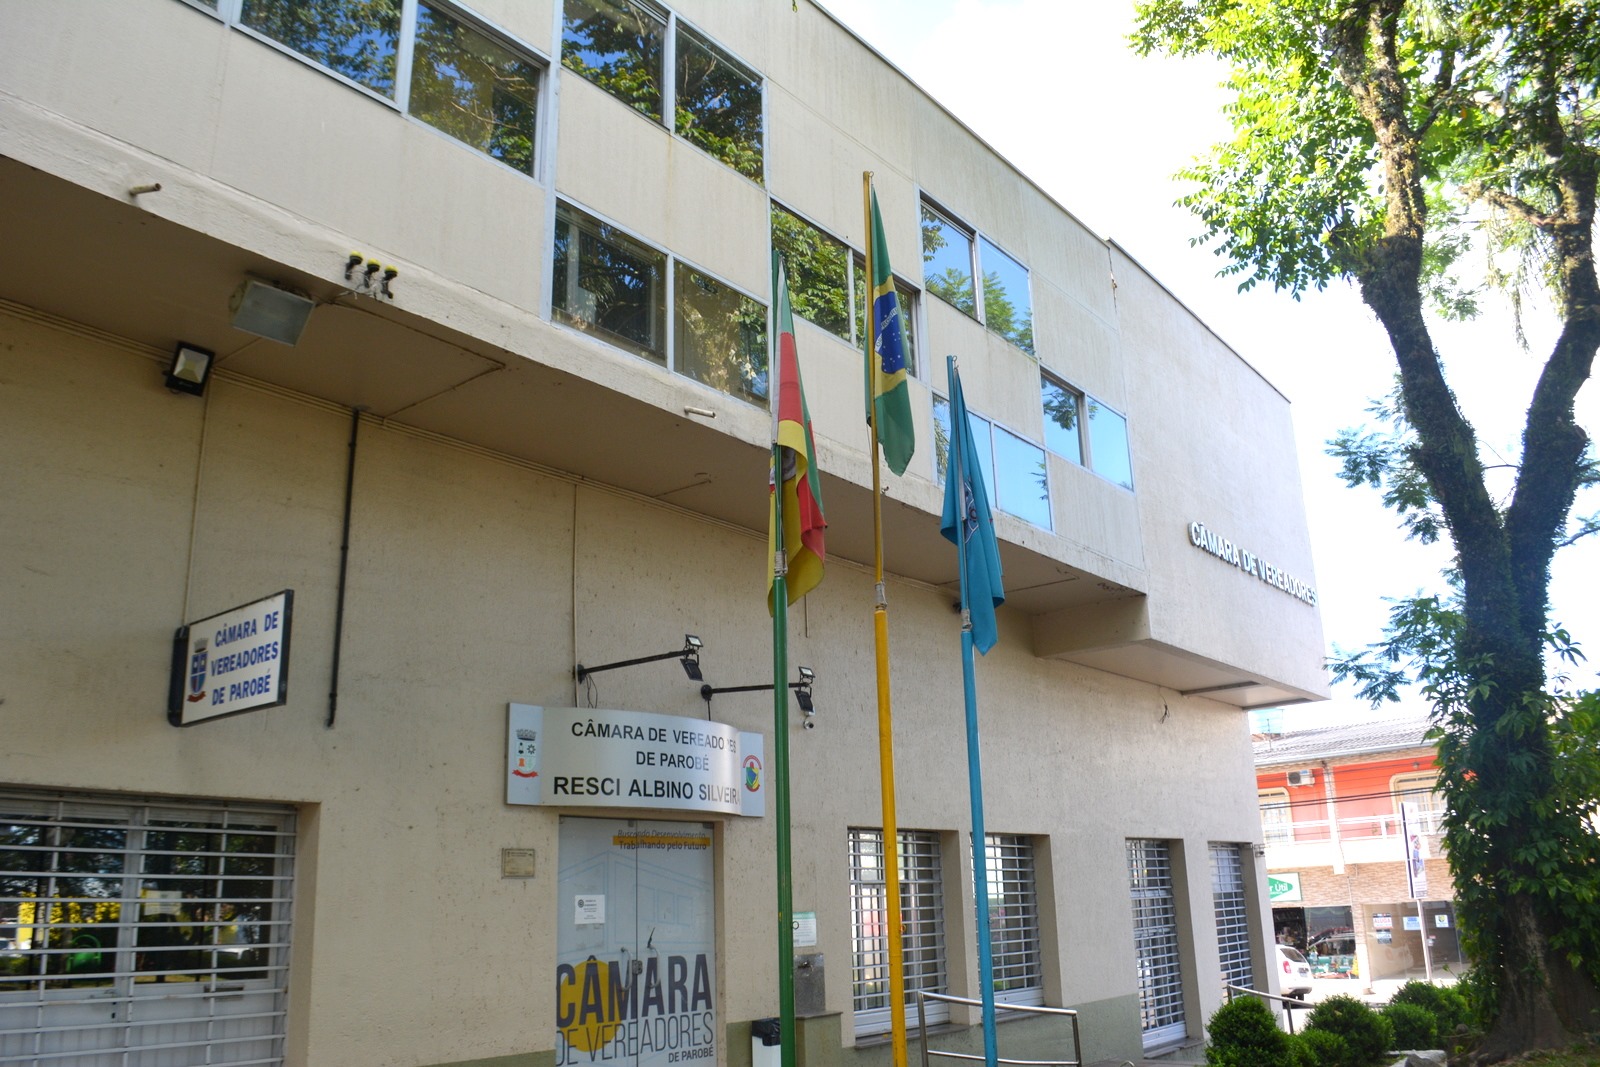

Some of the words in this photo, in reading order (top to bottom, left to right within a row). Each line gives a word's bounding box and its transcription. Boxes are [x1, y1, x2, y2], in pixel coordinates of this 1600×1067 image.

[1188, 521, 1241, 567] CÂMARA
[1241, 549, 1257, 576] DE
[1257, 558, 1318, 607] VEREADORES
[215, 618, 257, 647] CÂMARA
[264, 611, 279, 632] DE
[211, 641, 279, 676] VEREADORES
[212, 687, 226, 706] DE
[229, 668, 271, 701] PAROBÉ
[571, 719, 645, 741] CÂMARA
[648, 727, 667, 742] DE
[673, 729, 737, 753] VEREADOES
[636, 751, 655, 766] DE
[660, 753, 710, 771] PAROBÉ
[553, 776, 621, 796] RESCI
[628, 779, 693, 799] ALBINO
[620, 840, 665, 850] Trabalhando
[667, 841, 682, 852] pelo
[684, 841, 707, 850] Futuro
[652, 830, 706, 838] Desenvolvimento
[556, 954, 713, 1027] CÂMARA
[586, 1011, 714, 1063] VEREADORES
[668, 1052, 680, 1063] DE
[681, 1044, 714, 1061] PAROBÉ
